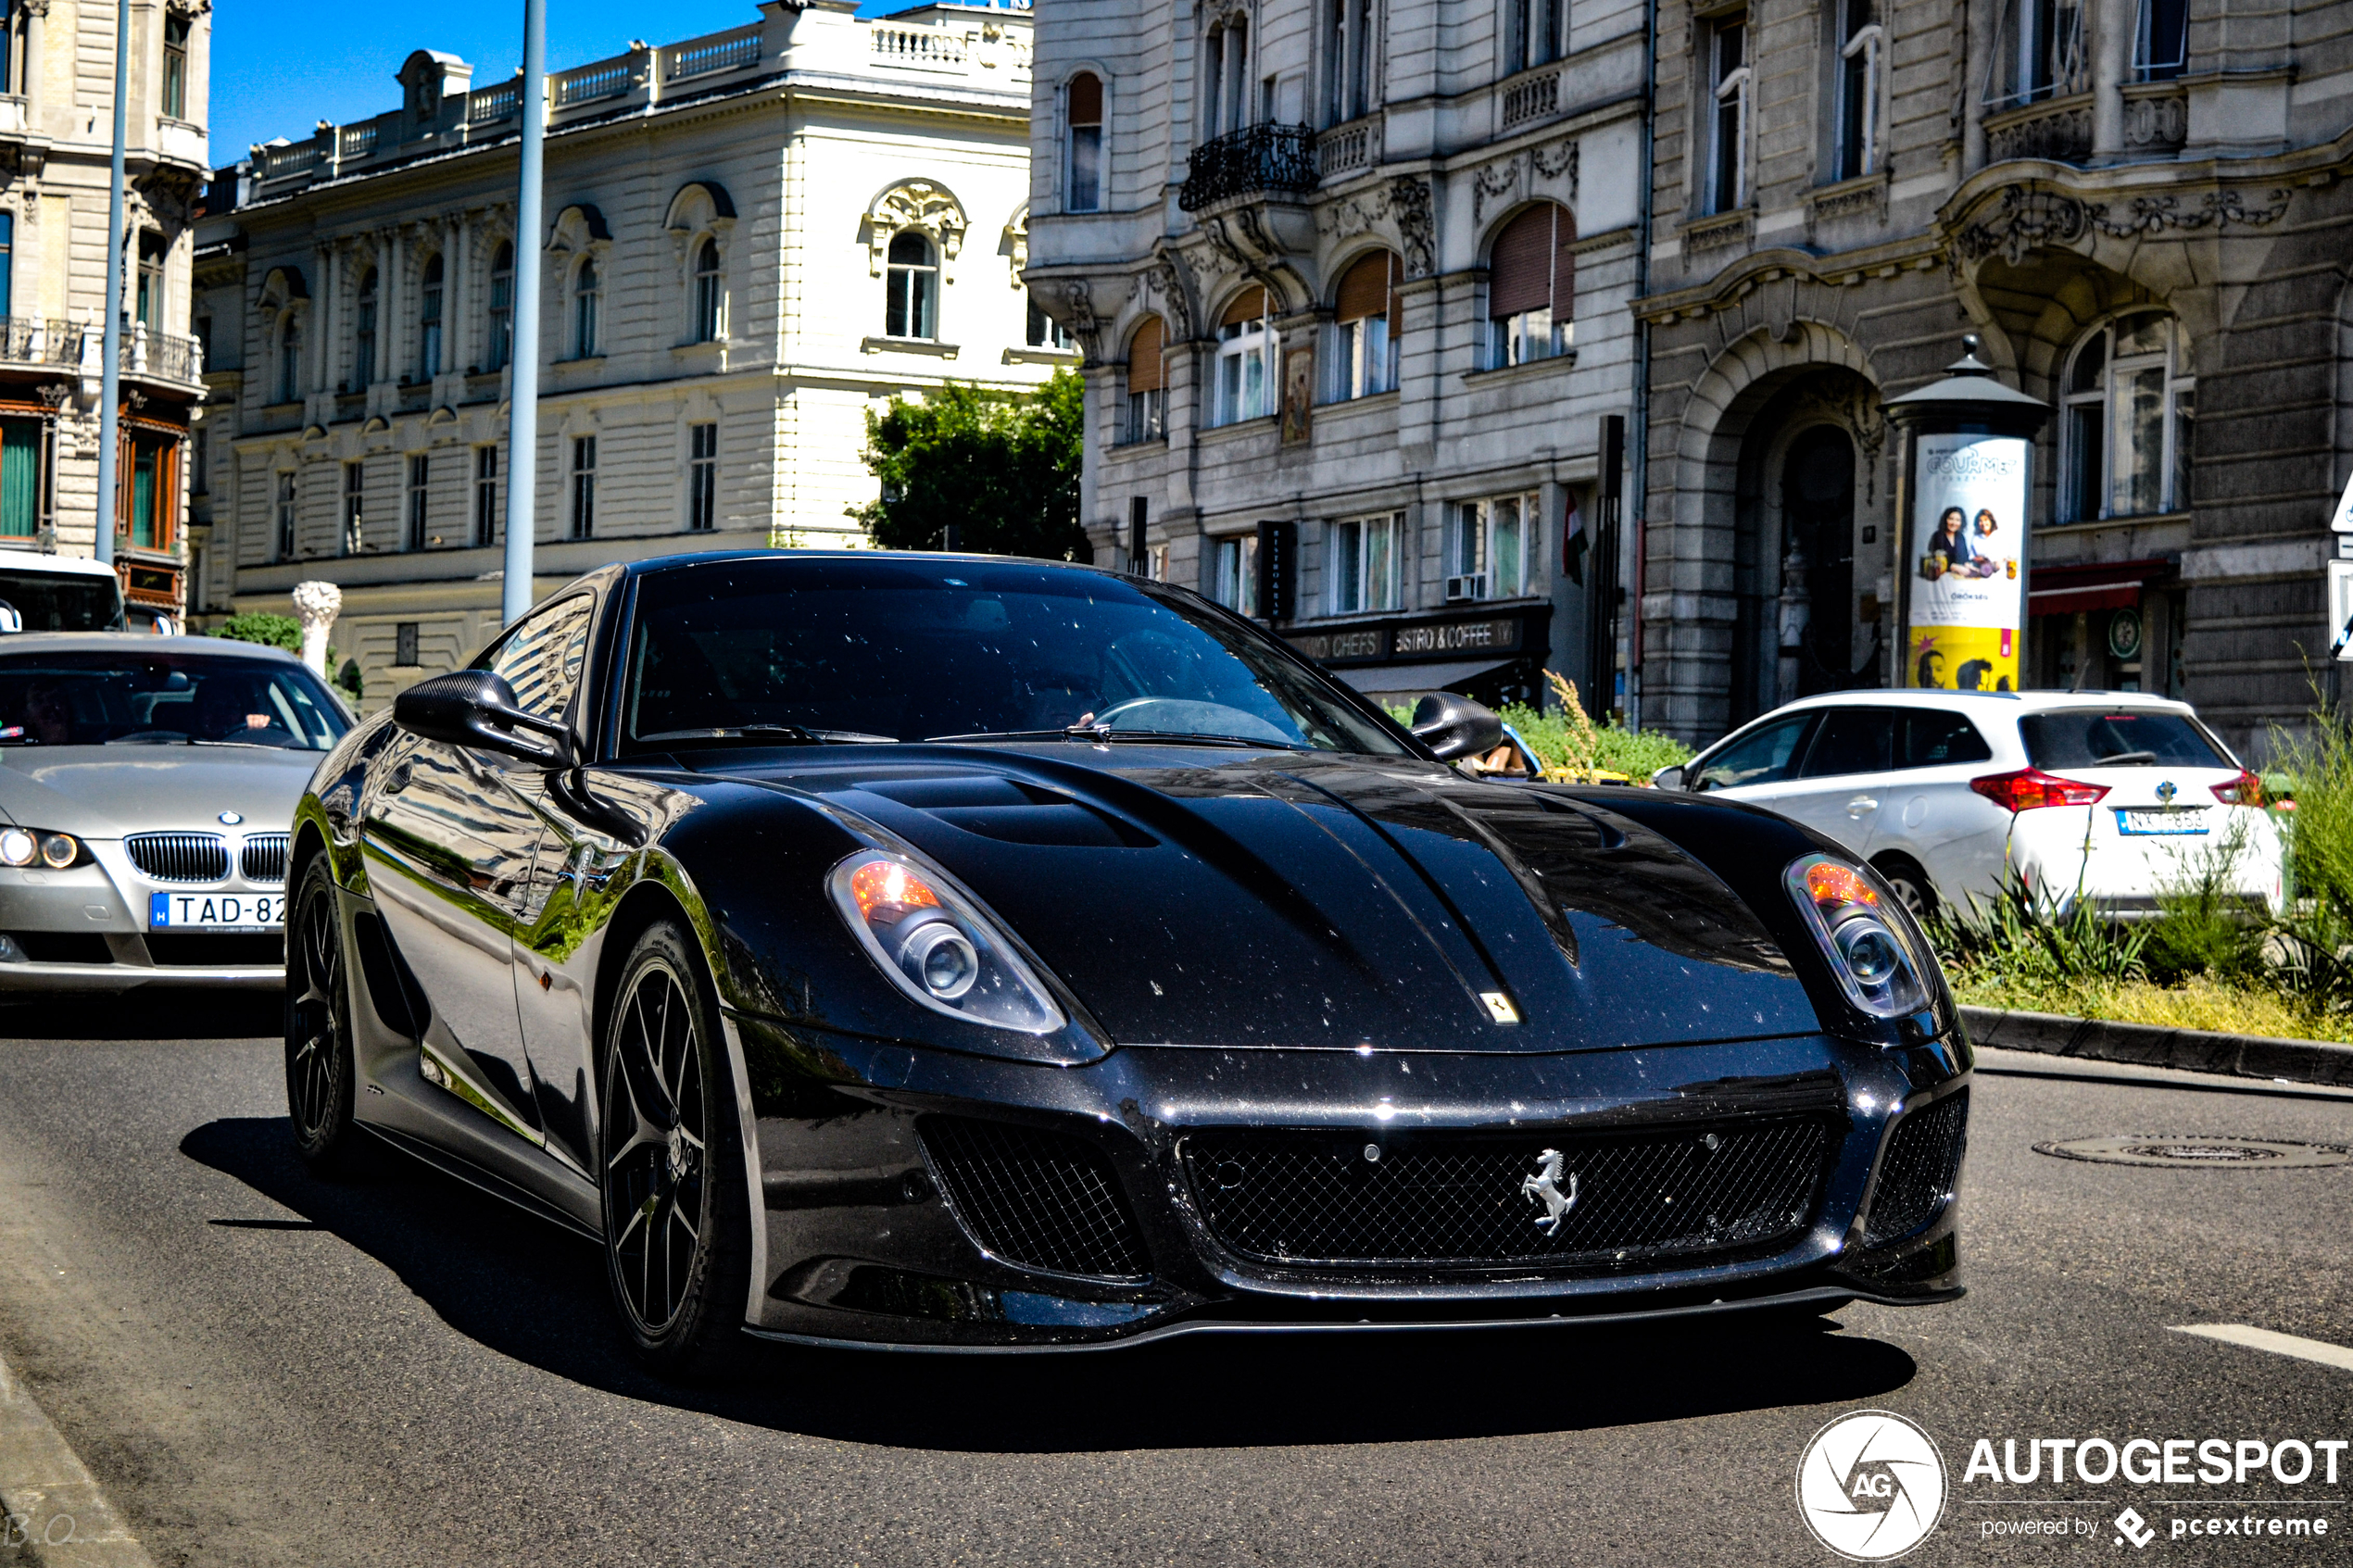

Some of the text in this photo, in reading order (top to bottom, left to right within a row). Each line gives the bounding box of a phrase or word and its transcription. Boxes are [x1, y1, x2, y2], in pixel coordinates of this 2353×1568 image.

[1331, 631, 1376, 658] CHEFS
[1395, 629, 1435, 652] BISTRO
[1437, 626, 1446, 648] &
[1447, 622, 1491, 648] COFFEE
[157, 911, 165, 922] H
